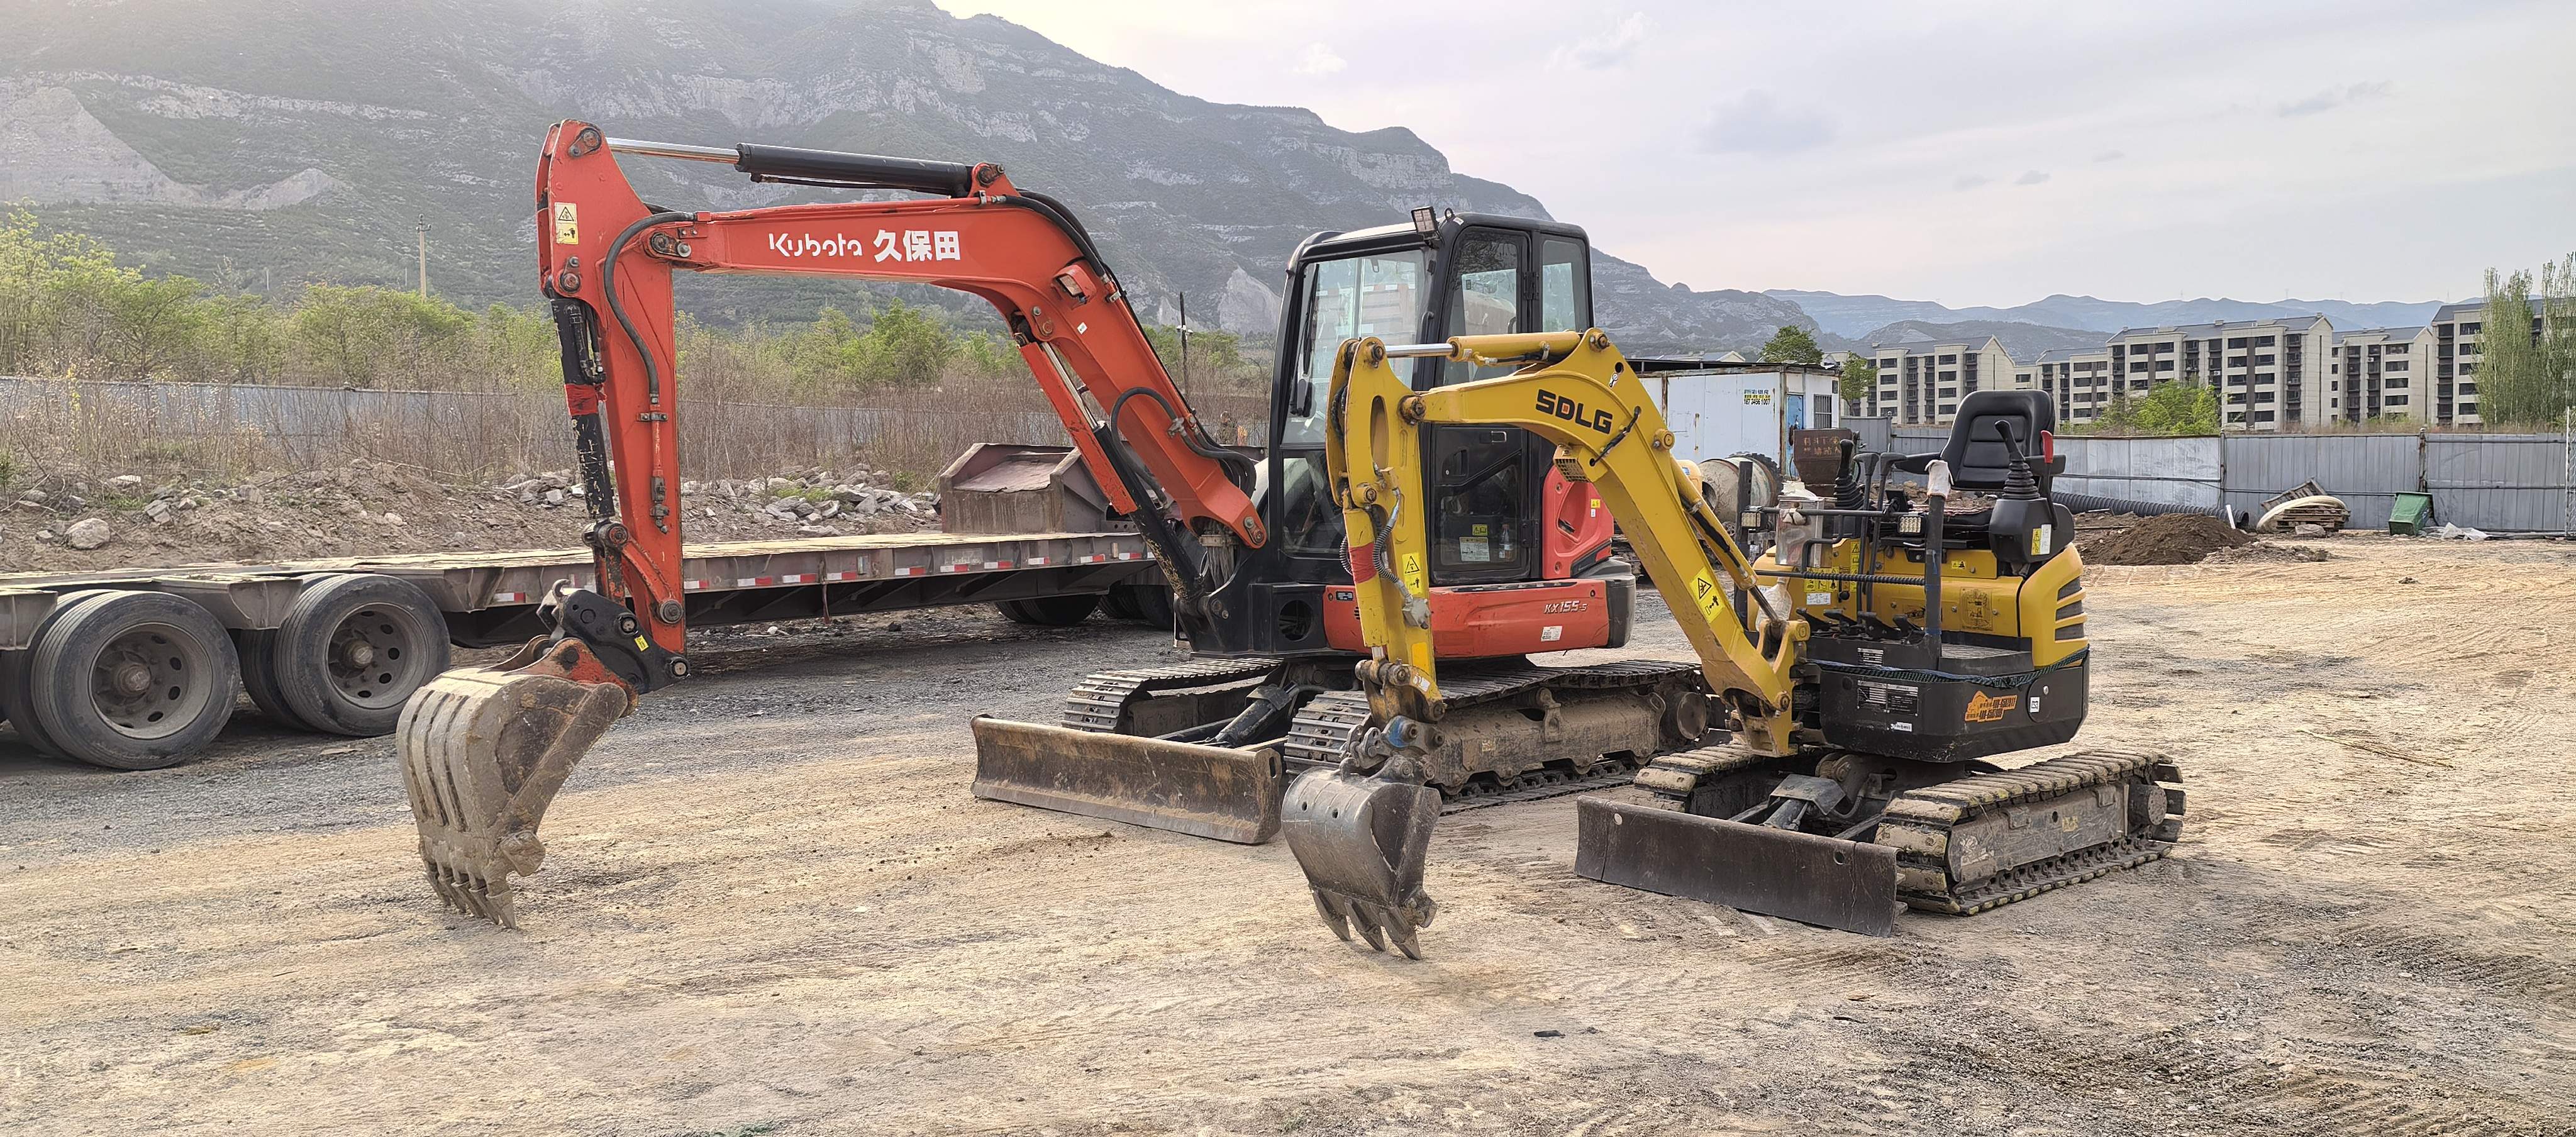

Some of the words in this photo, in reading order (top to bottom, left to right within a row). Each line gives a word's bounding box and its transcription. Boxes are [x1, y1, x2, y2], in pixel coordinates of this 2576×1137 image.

[769, 233, 863, 257] Kubota
[874, 230, 960, 262] 久保田
[1536, 389, 1613, 434] SDLG
